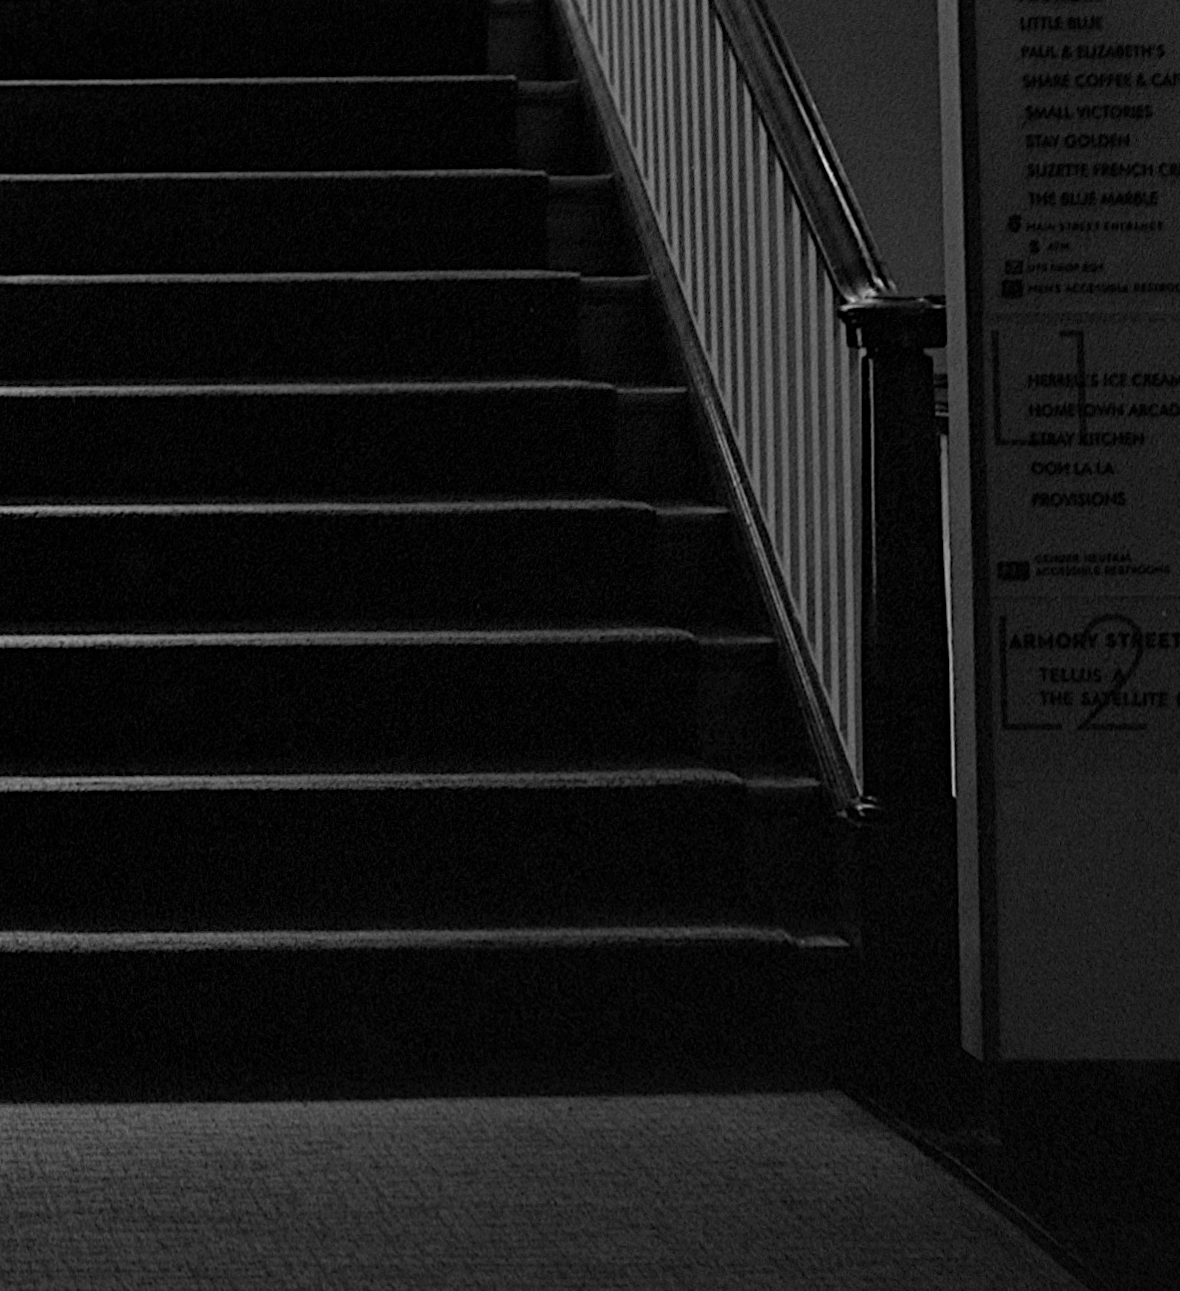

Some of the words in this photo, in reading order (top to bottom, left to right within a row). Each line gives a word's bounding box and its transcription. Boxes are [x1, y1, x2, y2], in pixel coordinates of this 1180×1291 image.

[1020, 15, 1064, 32] LITTLE
[1021, 44, 1058, 60] PAUL
[1060, 44, 1074, 60] &
[1022, 73, 1070, 89] SHARE
[1074, 72, 1132, 89] COFFEE
[1136, 73, 1147, 88] &
[1024, 104, 1074, 121] SMALL
[1076, 104, 1154, 120] VICTORIES
[1025, 133, 1060, 150] STAY
[1063, 133, 1131, 149] GOLDEN
[1026, 162, 1089, 179] SUZETTE
[1092, 162, 1155, 178] FRENCH
[1028, 191, 1057, 207] THE
[1059, 191, 1097, 207] BLUE
[1099, 190, 1159, 207] MARBLE
[1103, 372, 1128, 388] ICE
[1029, 431, 1075, 447] STRAY
[1077, 431, 1146, 447] KITCHEN
[1030, 460, 1071, 476] OOH
[1073, 461, 1093, 476] LA
[1095, 459, 1115, 476] LA
[1031, 491, 1127, 508] PROVISIONS
[1009, 632, 1099, 650] ARMORY
[1039, 666, 1103, 683] TELLUS
[1039, 690, 1074, 707] THE
[1080, 690, 1169, 708] SATELLITE
